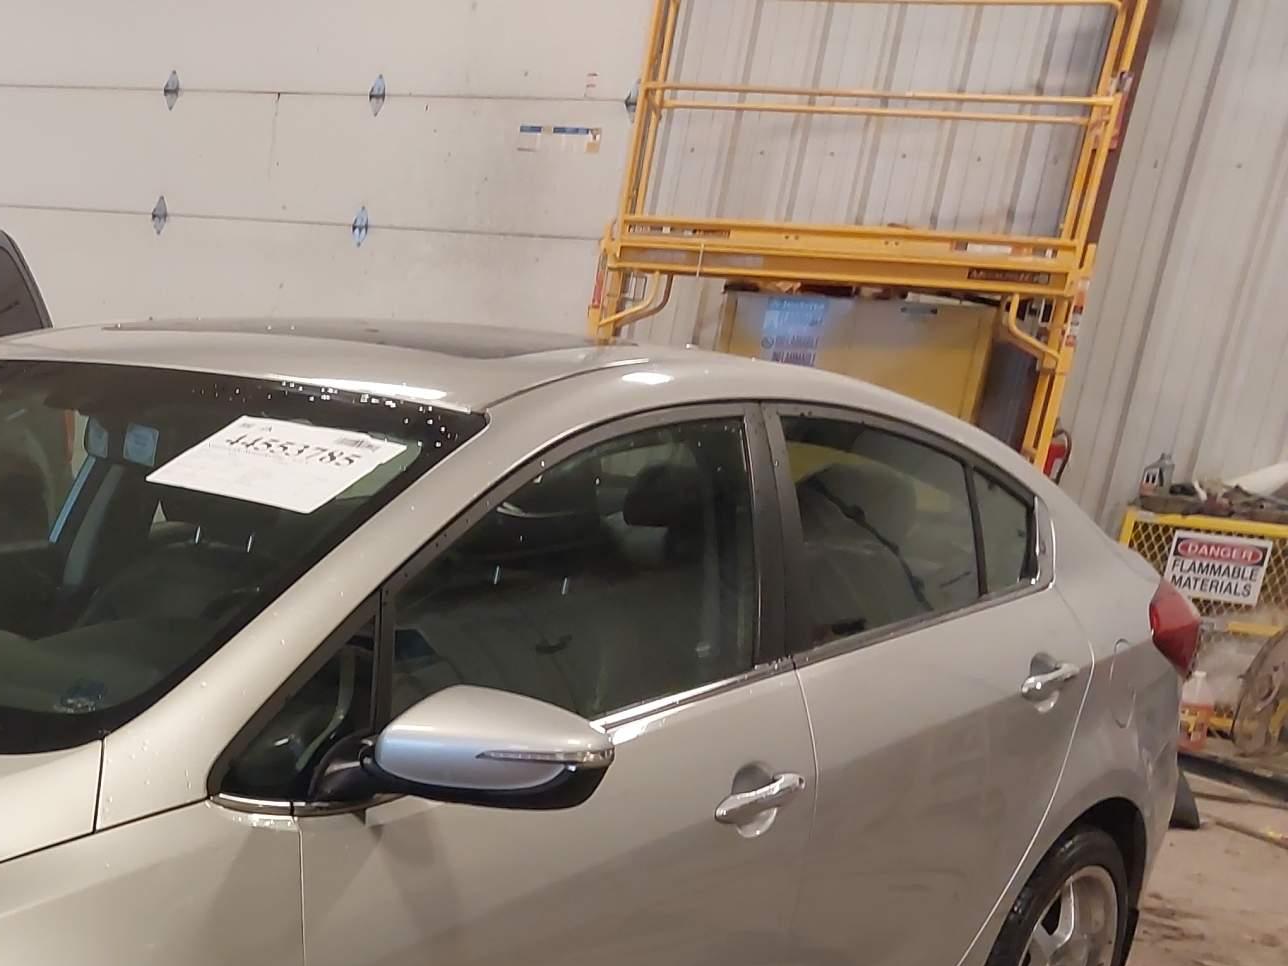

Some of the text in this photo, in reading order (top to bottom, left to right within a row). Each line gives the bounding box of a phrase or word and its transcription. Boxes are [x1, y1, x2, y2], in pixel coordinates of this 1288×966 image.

[225, 434, 363, 467] 44553785
[1187, 543, 1254, 562] DANGER
[1172, 558, 1259, 583] FLAMMABLE
[1171, 575, 1253, 598] MATERIALS
